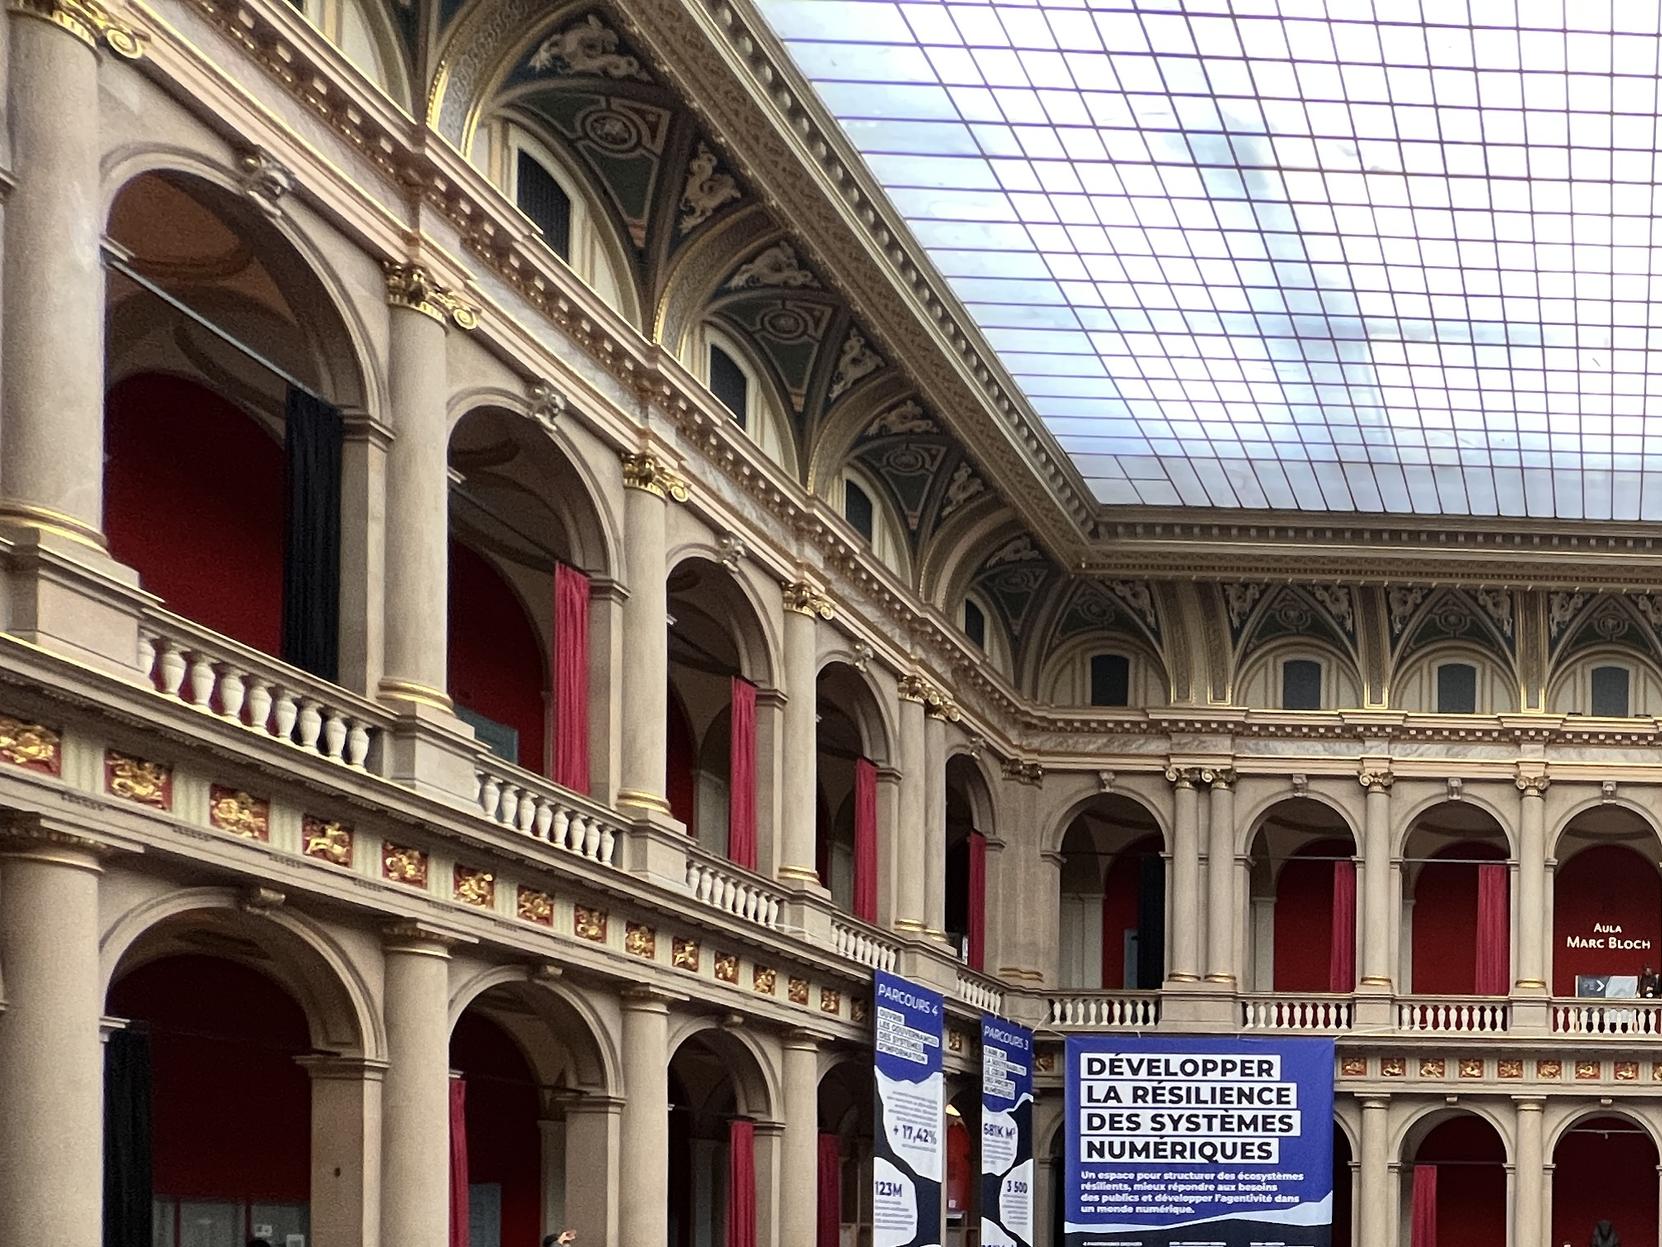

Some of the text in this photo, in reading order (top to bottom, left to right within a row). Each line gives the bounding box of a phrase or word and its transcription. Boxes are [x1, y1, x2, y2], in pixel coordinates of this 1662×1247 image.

[1566, 935, 1651, 950] MARC BLOCH
[878, 983, 939, 1017] PARCOURS 4
[983, 1025, 1029, 1050] PARCOURS 3
[1087, 1053, 1274, 1078] DÉVELOPPER
[1087, 1081, 1291, 1105] LA RÉSILIENCE
[1087, 1109, 1294, 1133] DES SYSTÈMES
[902, 1124, 937, 1145] 17,42%
[1087, 1137, 1272, 1163] NUMÉRIQUES
[1081, 1170, 1304, 1182] Un espace pour structurer des écosystèmes
[875, 1180, 902, 1198] 123M
[1013, 1181, 1028, 1194] 500
[1081, 1182, 1131, 1192] résilients,
[1134, 1182, 1165, 1191] mieux
[1168, 1182, 1215, 1192] répondre
[1238, 1182, 1277, 1191] besoins
[1081, 1193, 1299, 1204] des publics et développer l'agentivité dans
[1081, 1204, 1195, 1214] un monde numérique.
